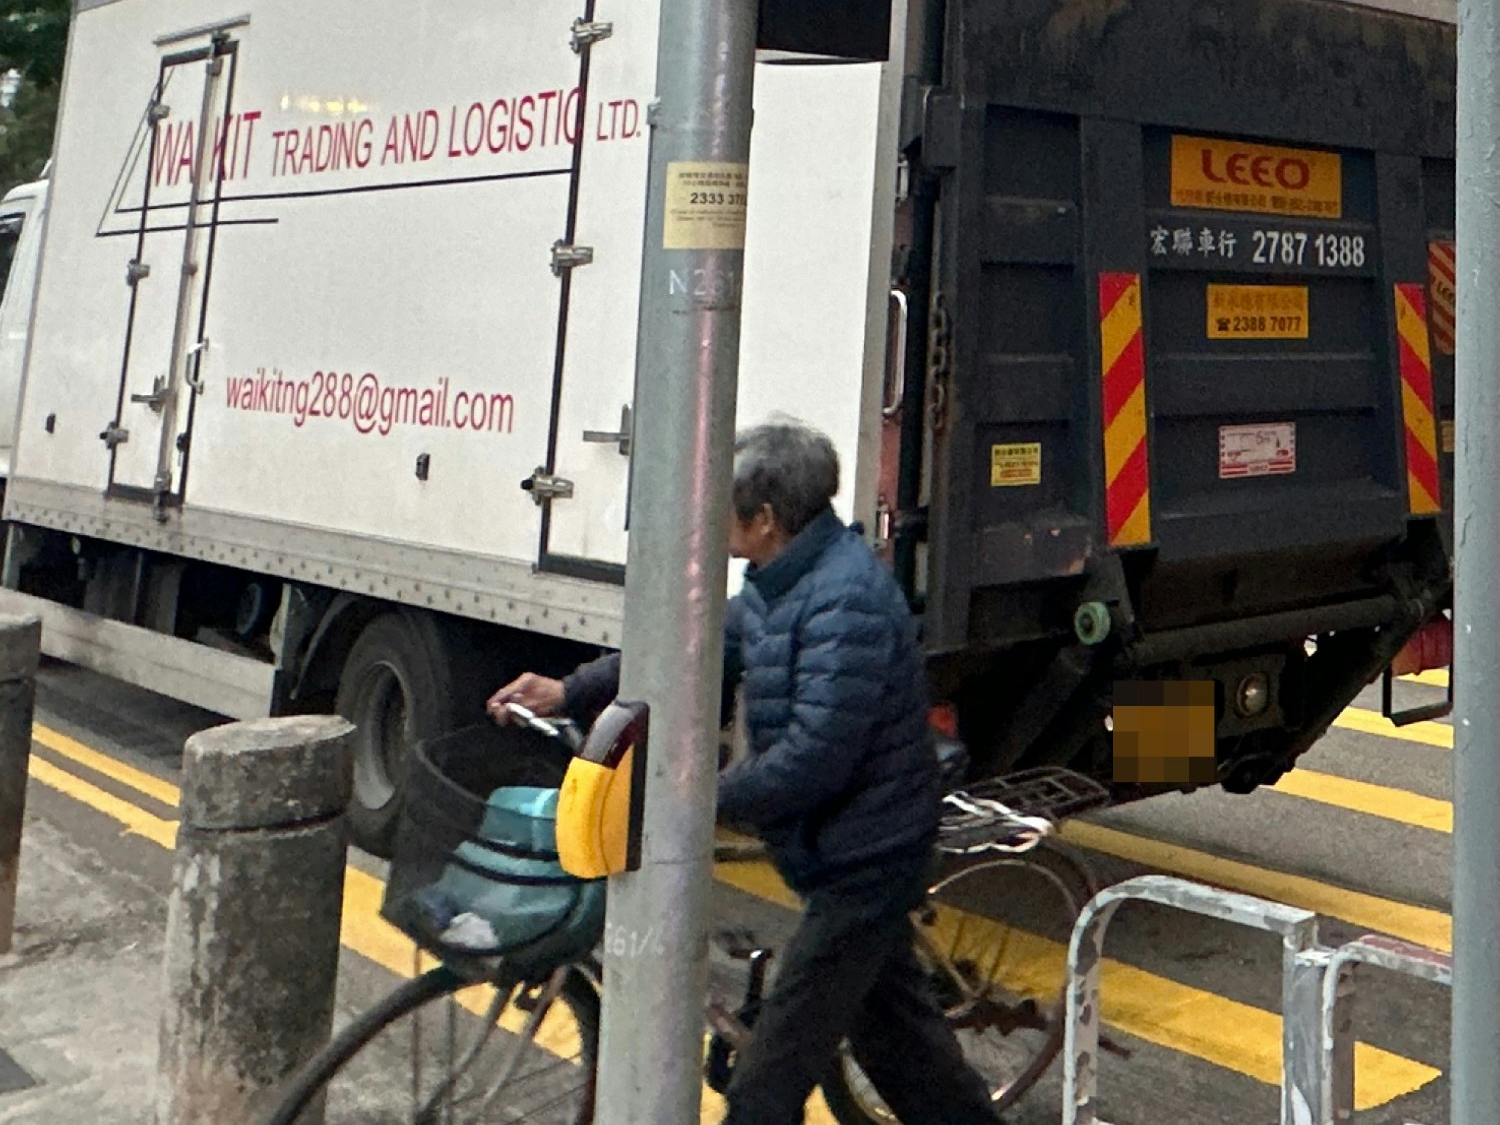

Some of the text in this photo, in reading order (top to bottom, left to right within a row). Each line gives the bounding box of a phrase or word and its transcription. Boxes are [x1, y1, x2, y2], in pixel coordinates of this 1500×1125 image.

[272, 119, 373, 176] TRADING
[381, 99, 439, 165] AND
[596, 98, 642, 142] LTD.
[690, 192, 724, 205] 2333
[1252, 230, 1308, 264] 2787
[1314, 233, 1365, 267] 1388
[1232, 316, 1302, 332] 2388 7077
[226, 367, 514, 435] waikitng288@gmail.com
